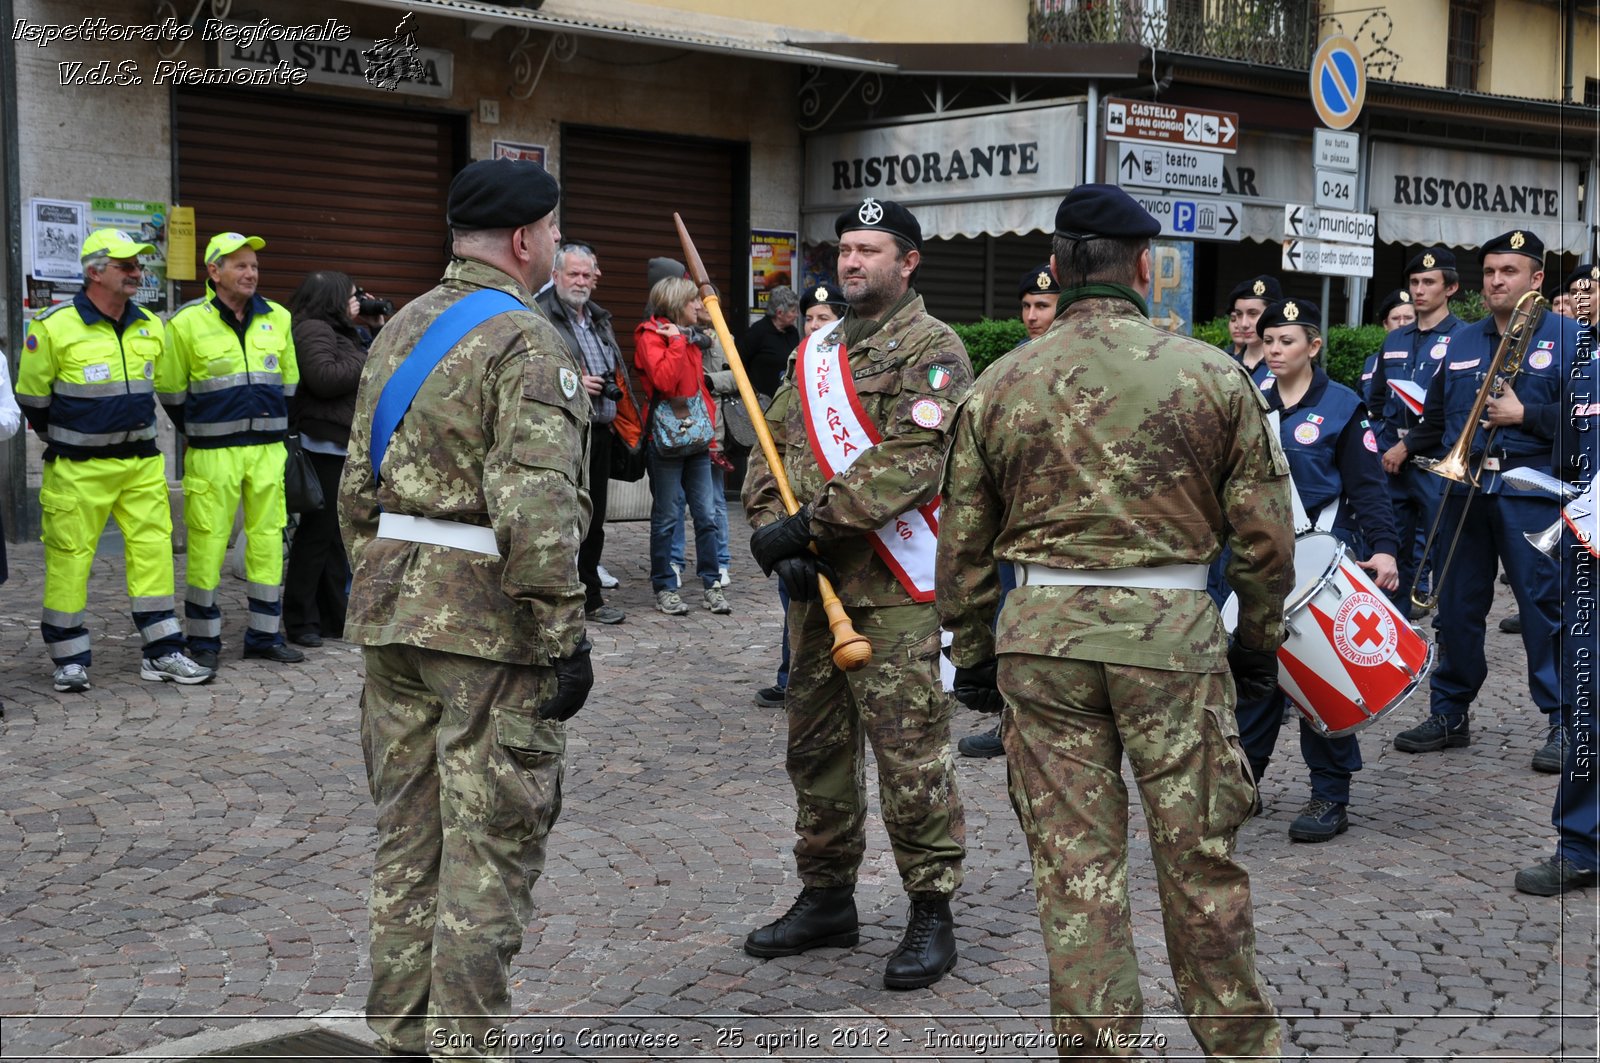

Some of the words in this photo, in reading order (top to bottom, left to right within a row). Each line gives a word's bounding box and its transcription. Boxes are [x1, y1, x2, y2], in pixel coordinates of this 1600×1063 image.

[230, 36, 282, 64] LA
[293, 41, 443, 87] STAA
[1130, 103, 1178, 120] CASTELLO
[1126, 116, 1134, 126] di
[1135, 117, 1151, 128] SAN
[1152, 119, 1184, 132] GIORGIO
[1324, 139, 1332, 147] su
[1334, 138, 1349, 149] tutta
[831, 141, 1040, 191] RISTORANTE
[1166, 151, 1198, 168] teatro
[1322, 152, 1328, 161] la
[1330, 153, 1350, 164] piazza
[1165, 171, 1218, 188] comunale
[1222, 164, 1260, 197] AR
[1322, 180, 1350, 200] 0-24
[1393, 174, 1559, 217] RISTORANTE
[1138, 199, 1171, 214] CIVICO
[1318, 215, 1375, 240] municipio
[1320, 251, 1337, 264] centro
[1338, 251, 1359, 268] sportivo
[1153, 246, 1181, 304] P
[932, 365, 950, 375] ITALIA
[816, 358, 830, 399] INTER
[826, 406, 858, 457] ARMA
[895, 516, 913, 541] AS
[1362, 594, 1369, 602] 22
[1337, 596, 1362, 623] GINEVRA
[1369, 598, 1392, 625] AGOSTO
[1335, 623, 1344, 632] DI
[1388, 628, 1396, 646] 1864
[1335, 634, 1384, 665] CONVENZIONE
